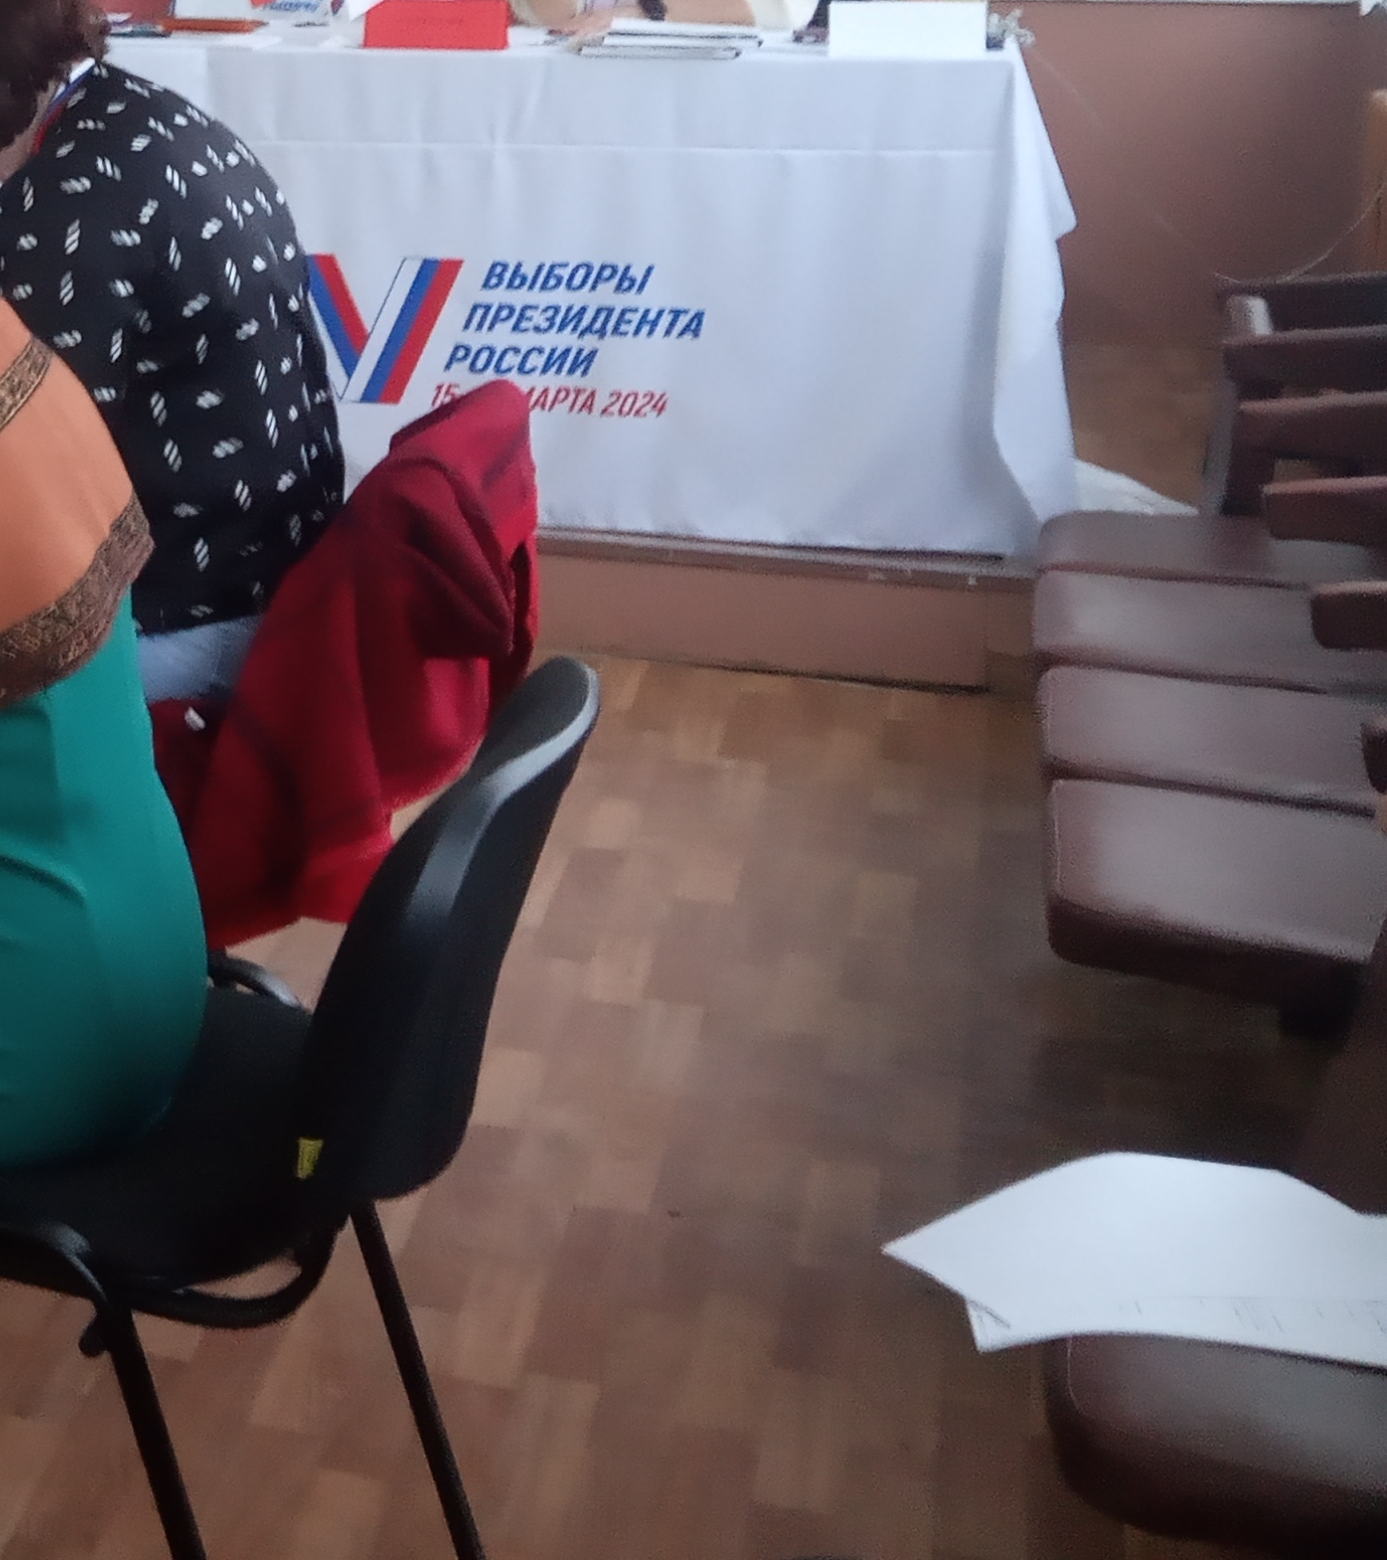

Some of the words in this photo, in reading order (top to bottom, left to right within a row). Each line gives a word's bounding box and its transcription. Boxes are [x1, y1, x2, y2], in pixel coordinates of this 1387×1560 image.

[480, 260, 655, 296] ВЫБОРЫ
[462, 303, 707, 341] ПРЕЗИДЕНТА
[443, 342, 599, 378] РОССИИ
[600, 390, 669, 419] 2024
